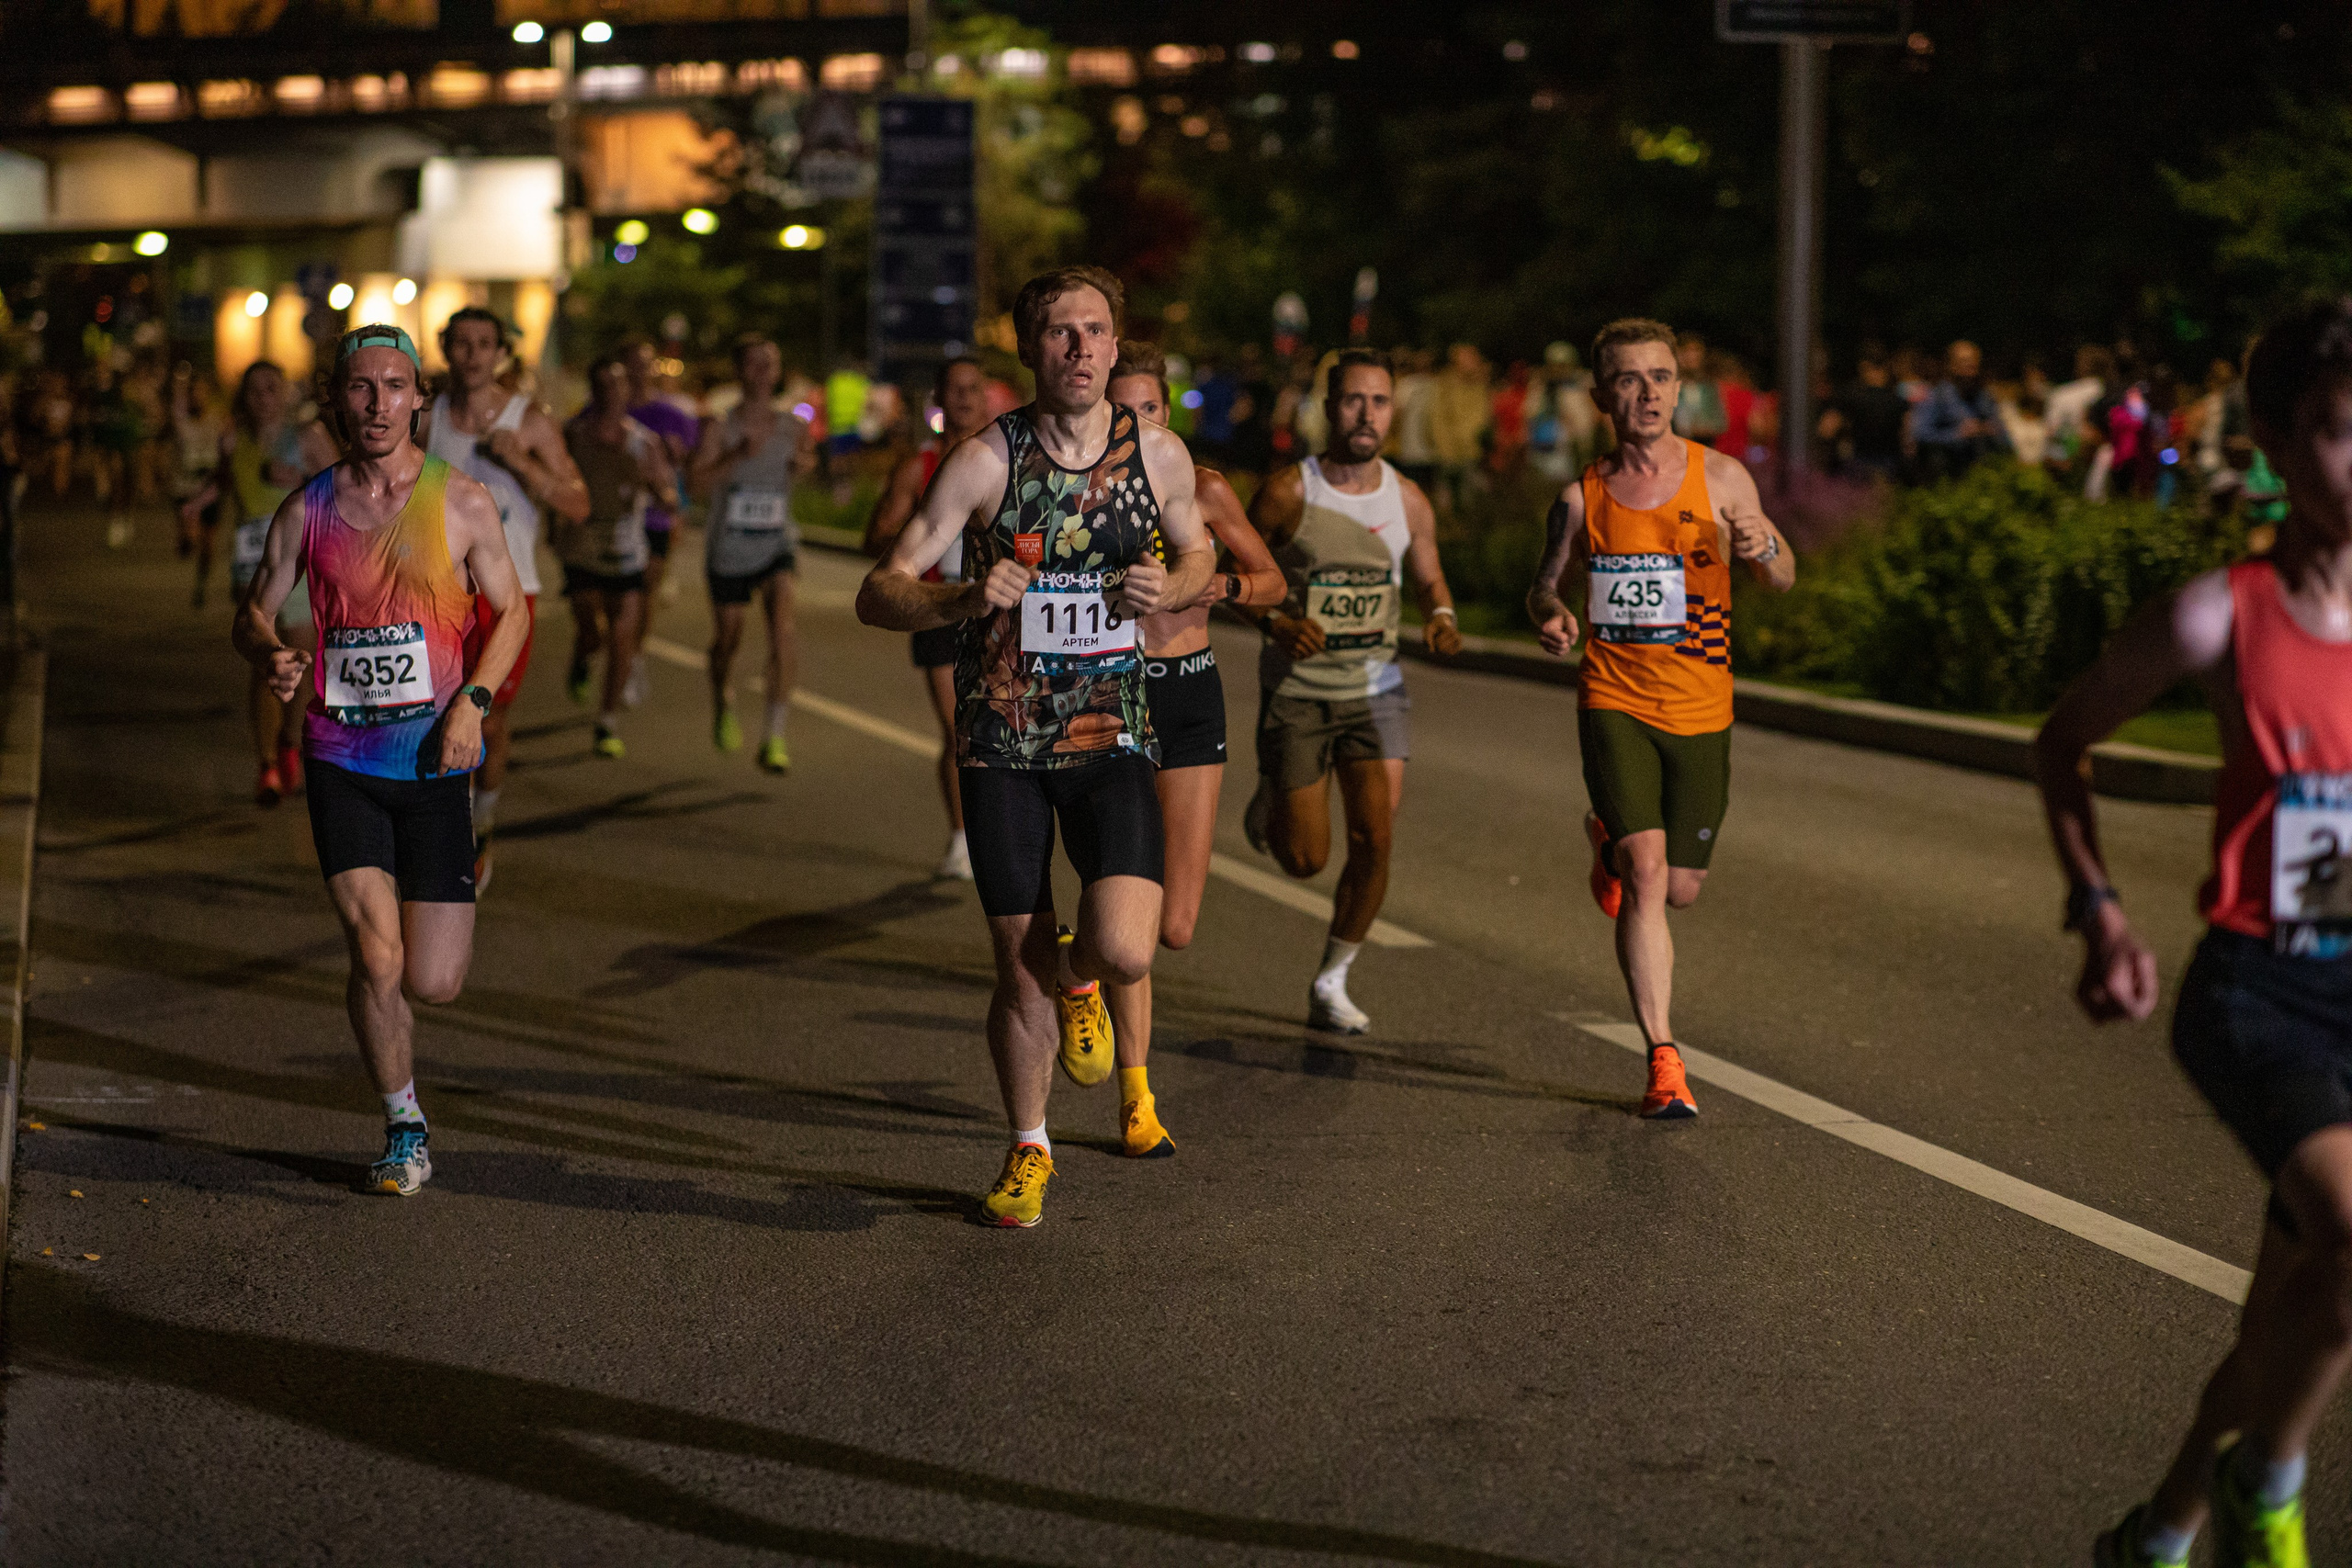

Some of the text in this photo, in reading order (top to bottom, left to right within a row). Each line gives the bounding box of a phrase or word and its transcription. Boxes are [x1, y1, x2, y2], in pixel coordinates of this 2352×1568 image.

[1320, 593, 1382, 618] 4307
[1608, 581, 1663, 607] 435
[1040, 600, 1123, 635] 1116
[1062, 637, 1100, 648] АРТЕМ
[339, 653, 417, 688] 4352
[363, 688, 391, 699] ИЛЬЯ
